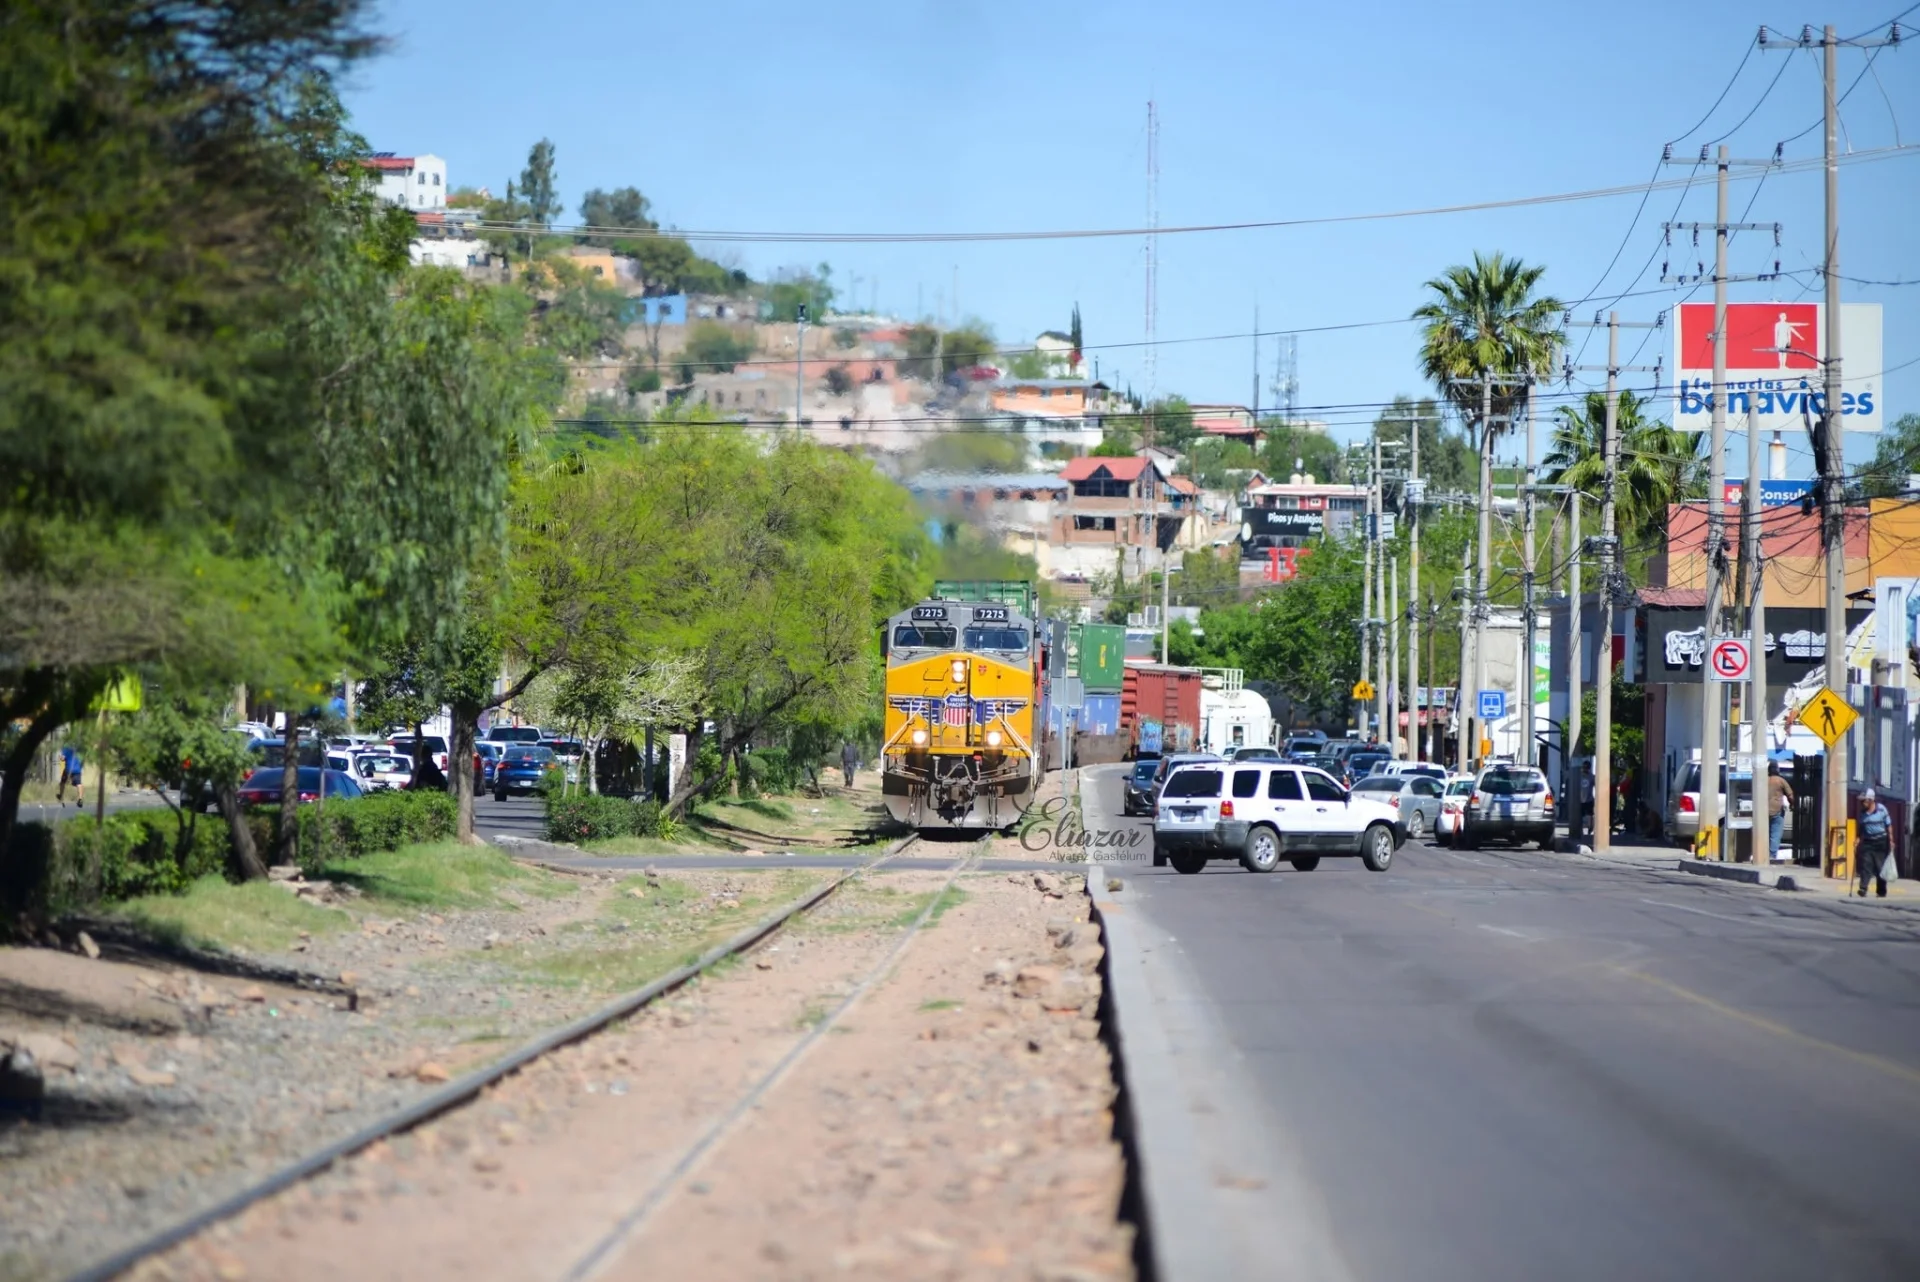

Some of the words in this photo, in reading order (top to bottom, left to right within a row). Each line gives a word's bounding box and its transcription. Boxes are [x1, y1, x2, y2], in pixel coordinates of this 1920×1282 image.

[1694, 378, 1784, 390] famacias
[1268, 512, 1286, 523] Pisos
[1287, 515, 1294, 525] y
[1293, 513, 1324, 526] Azulejos
[919, 608, 943, 618] 7275
[980, 610, 1004, 619] 7275
